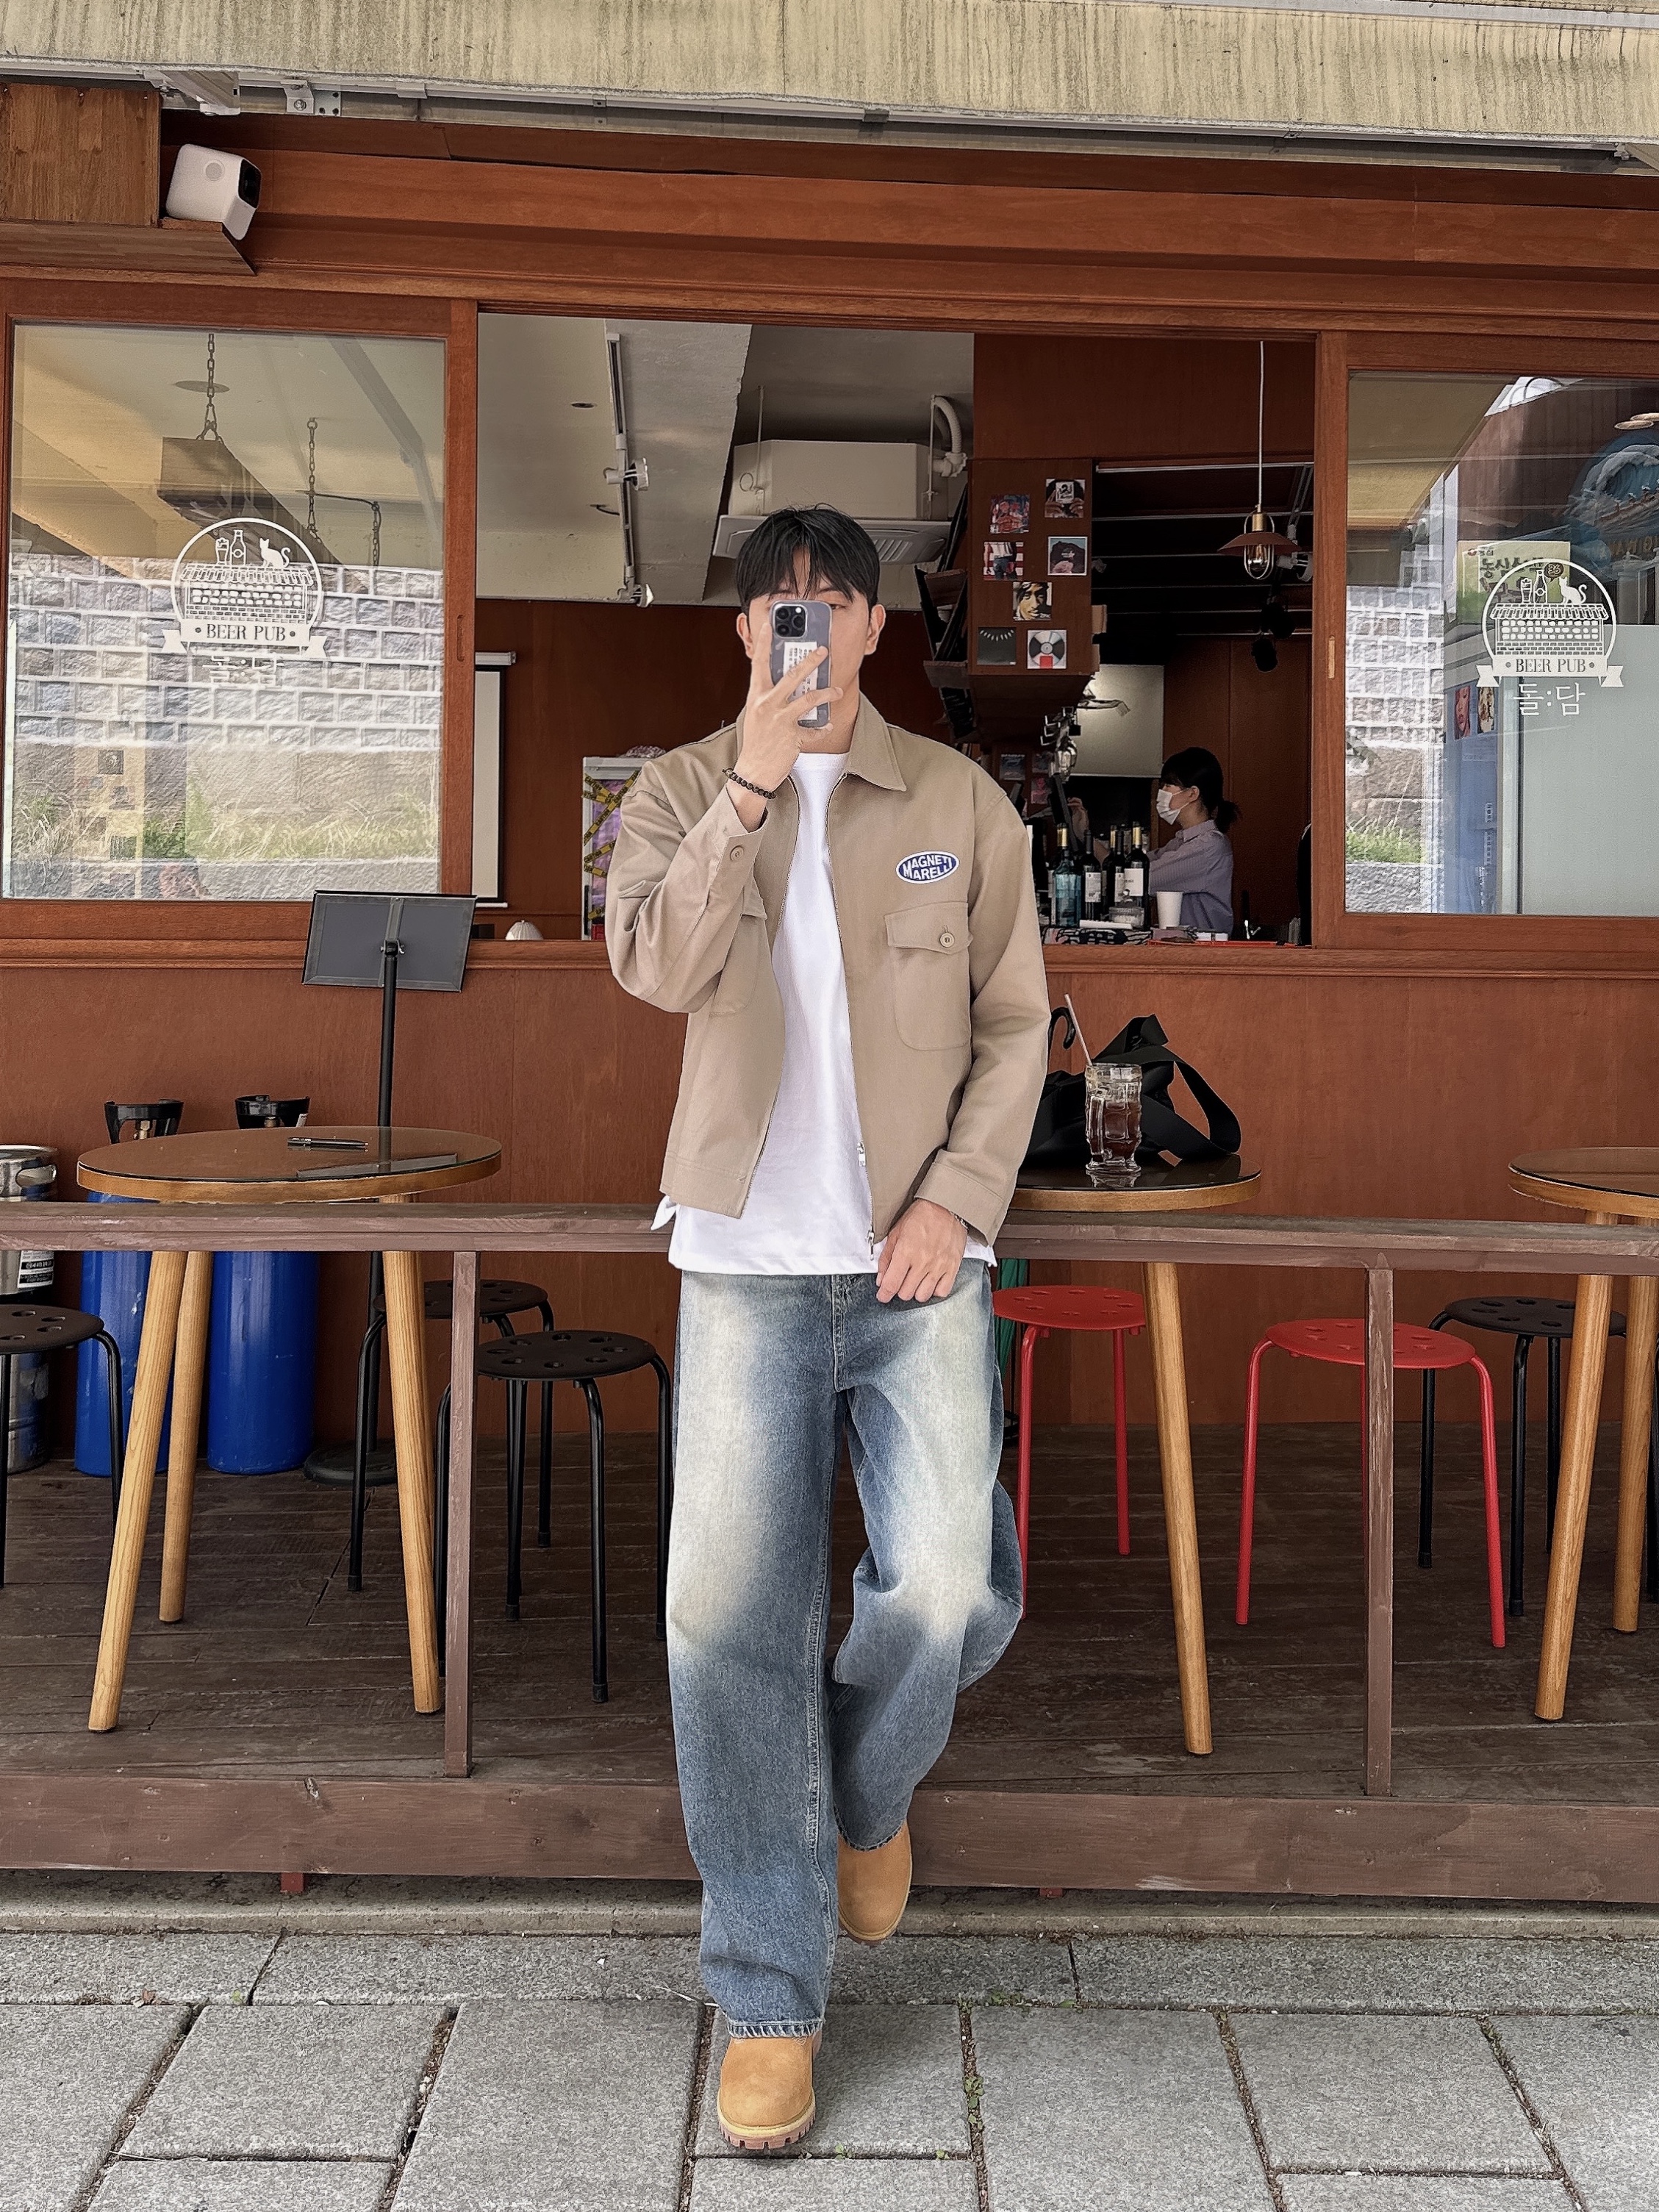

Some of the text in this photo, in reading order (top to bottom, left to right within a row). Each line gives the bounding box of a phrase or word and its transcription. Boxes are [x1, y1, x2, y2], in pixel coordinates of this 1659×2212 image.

[207, 623, 286, 641] BEER PUB
[1516, 658, 1586, 673] BEER PUB
[903, 855, 953, 872] MAGNETI
[903, 863, 953, 880] MARELLI
